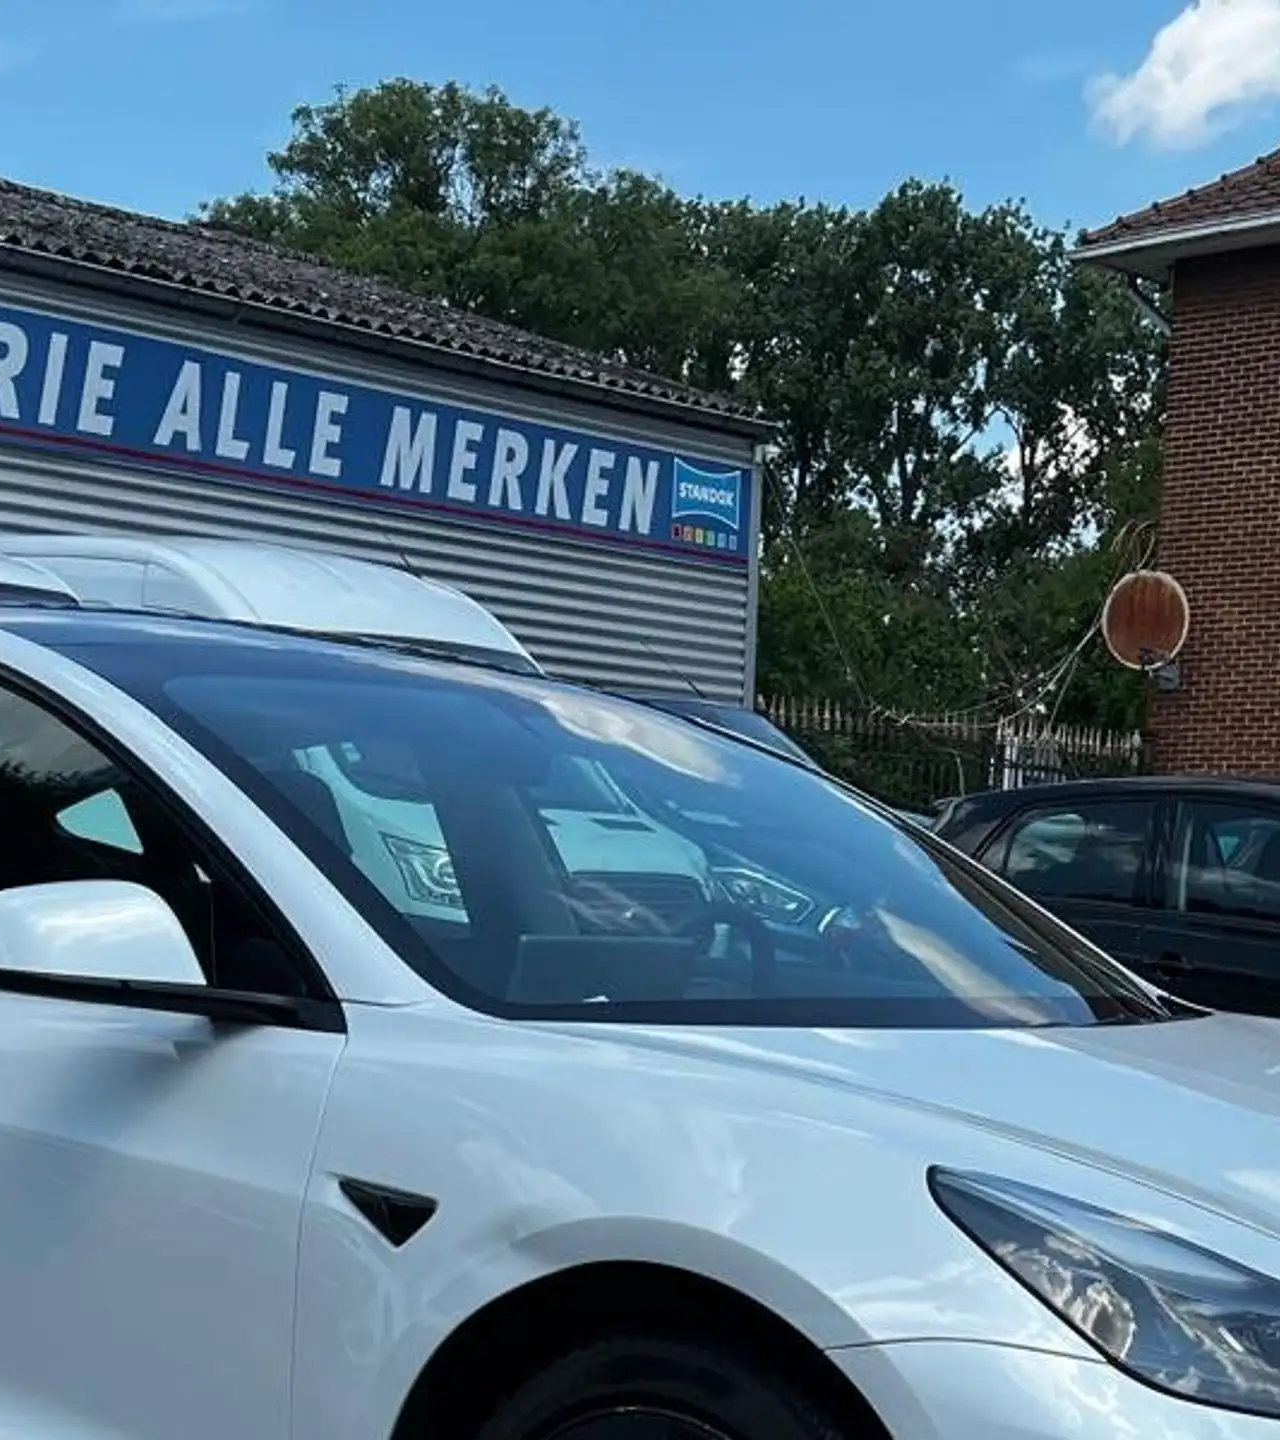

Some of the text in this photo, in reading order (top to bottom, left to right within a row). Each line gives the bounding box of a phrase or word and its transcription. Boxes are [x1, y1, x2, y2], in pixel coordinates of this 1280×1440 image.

[152, 360, 351, 478] ALLE
[379, 405, 661, 536] MERKEN
[678, 482, 735, 507] STANDOX
